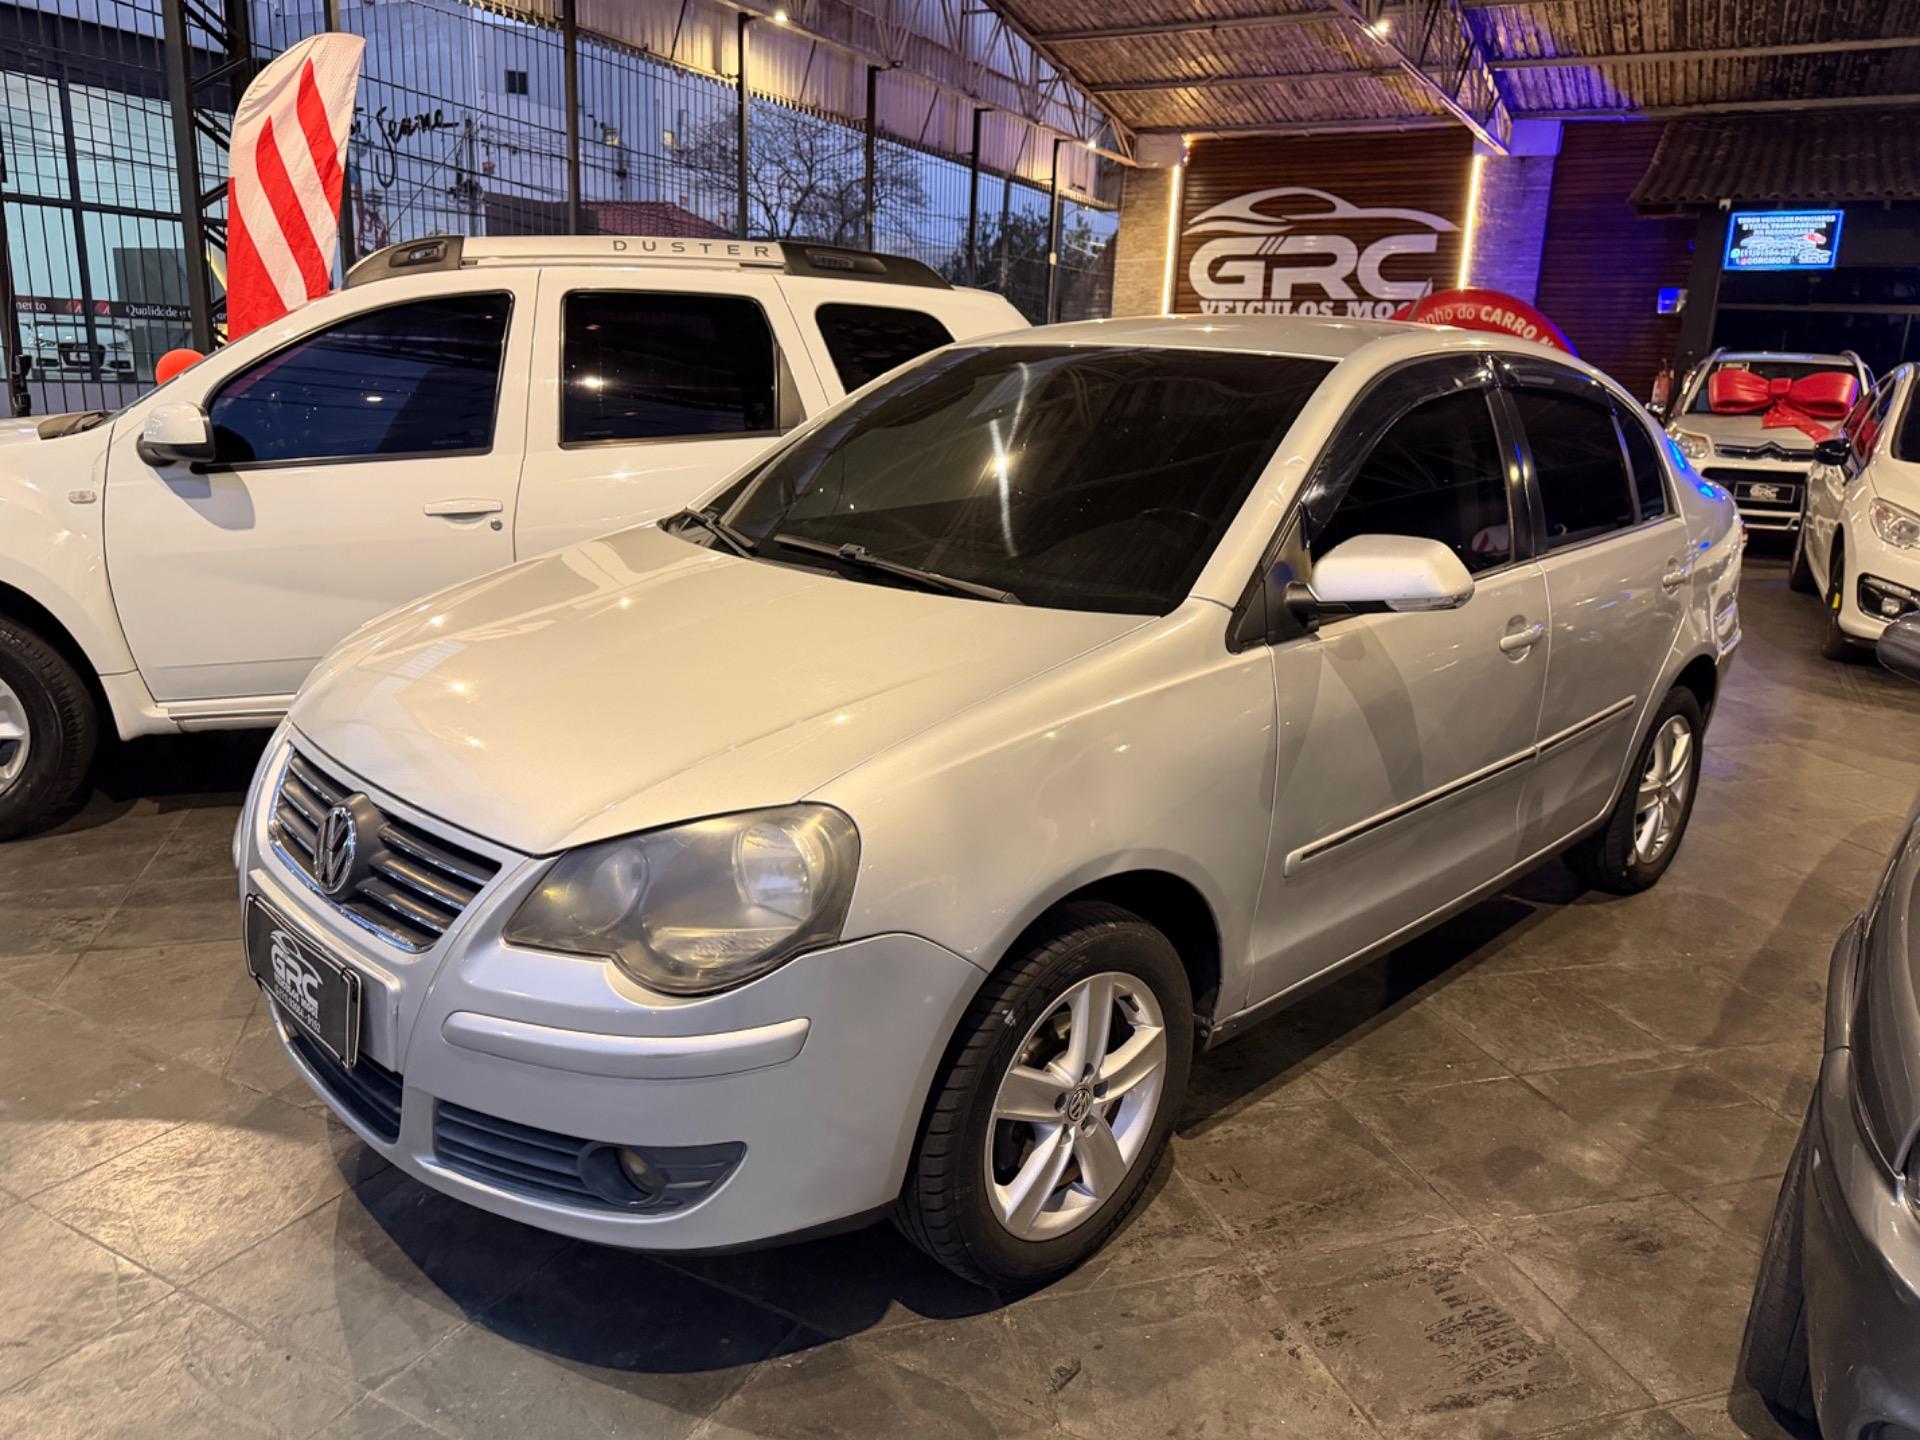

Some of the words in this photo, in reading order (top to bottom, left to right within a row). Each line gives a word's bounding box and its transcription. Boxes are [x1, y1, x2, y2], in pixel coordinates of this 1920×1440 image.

[612, 240, 769, 257] DUSTER
[1189, 234, 1438, 300] GRC
[1347, 302, 1410, 319] MO
[1457, 304, 1475, 320] do
[1480, 305, 1537, 340] CARRO
[271, 944, 318, 1009] GRC
